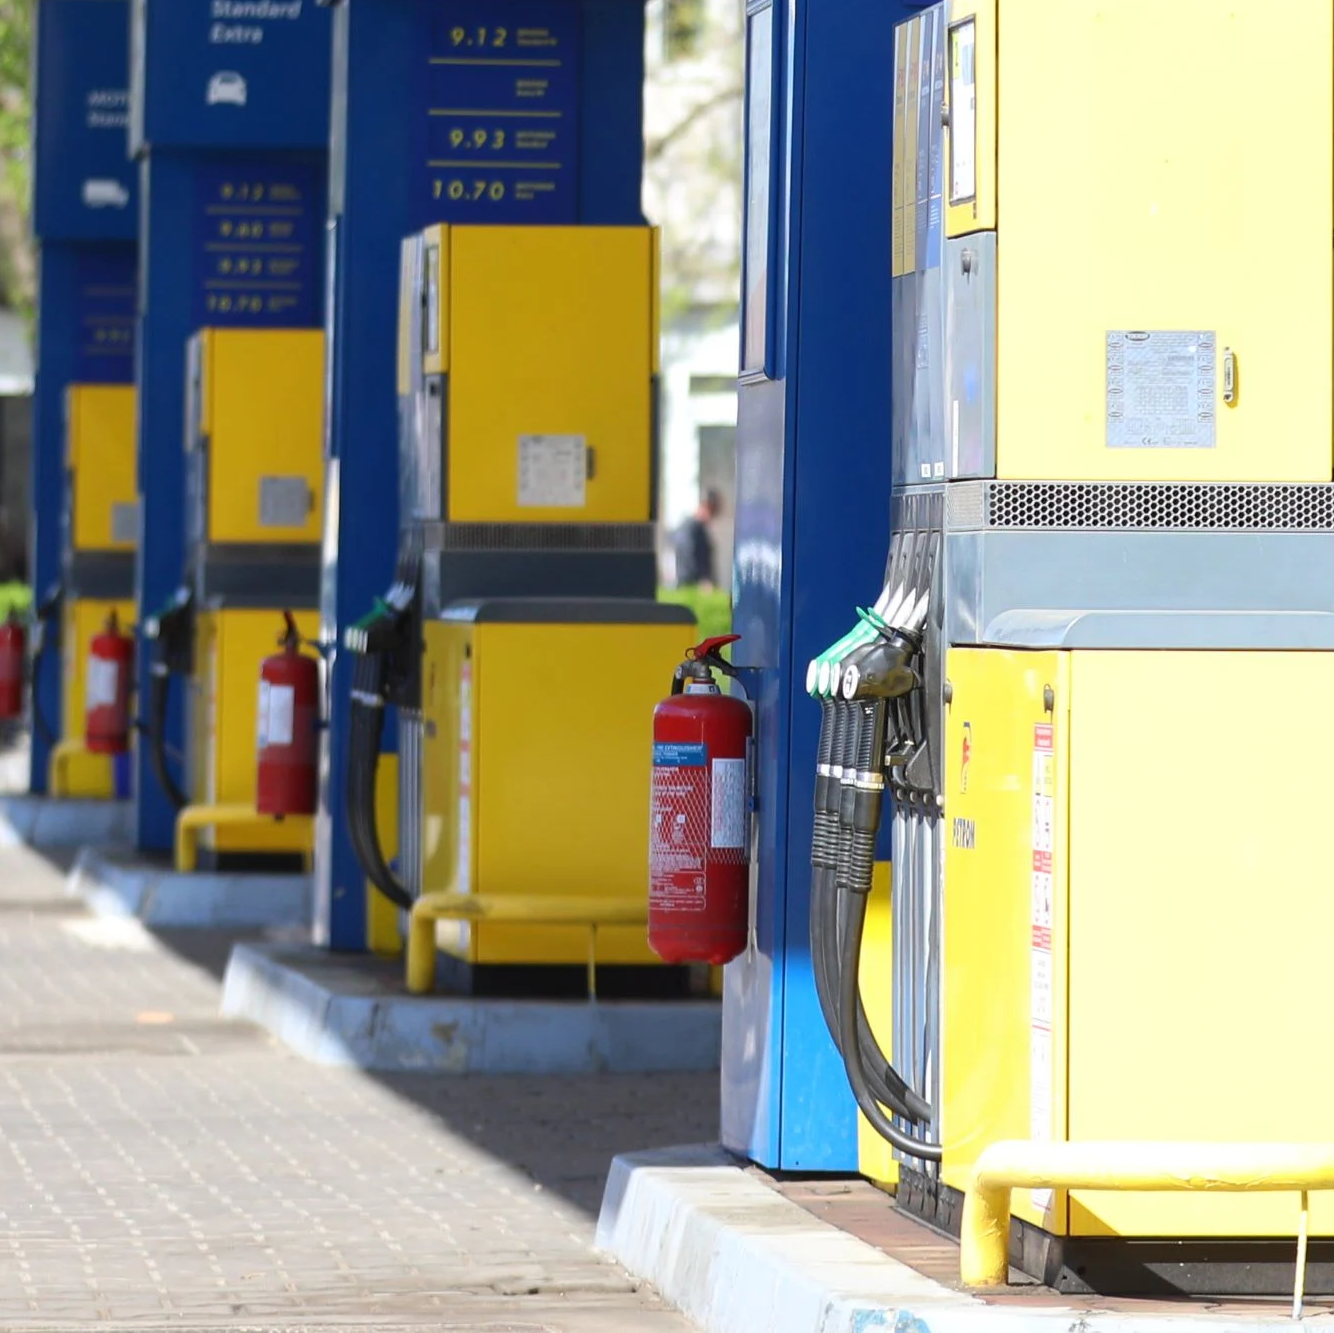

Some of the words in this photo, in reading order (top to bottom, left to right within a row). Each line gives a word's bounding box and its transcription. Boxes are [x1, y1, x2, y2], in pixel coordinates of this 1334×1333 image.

[211, 23, 263, 43] Extra
[451, 27, 507, 46] 9.12
[434, 180, 504, 200] 10.70
